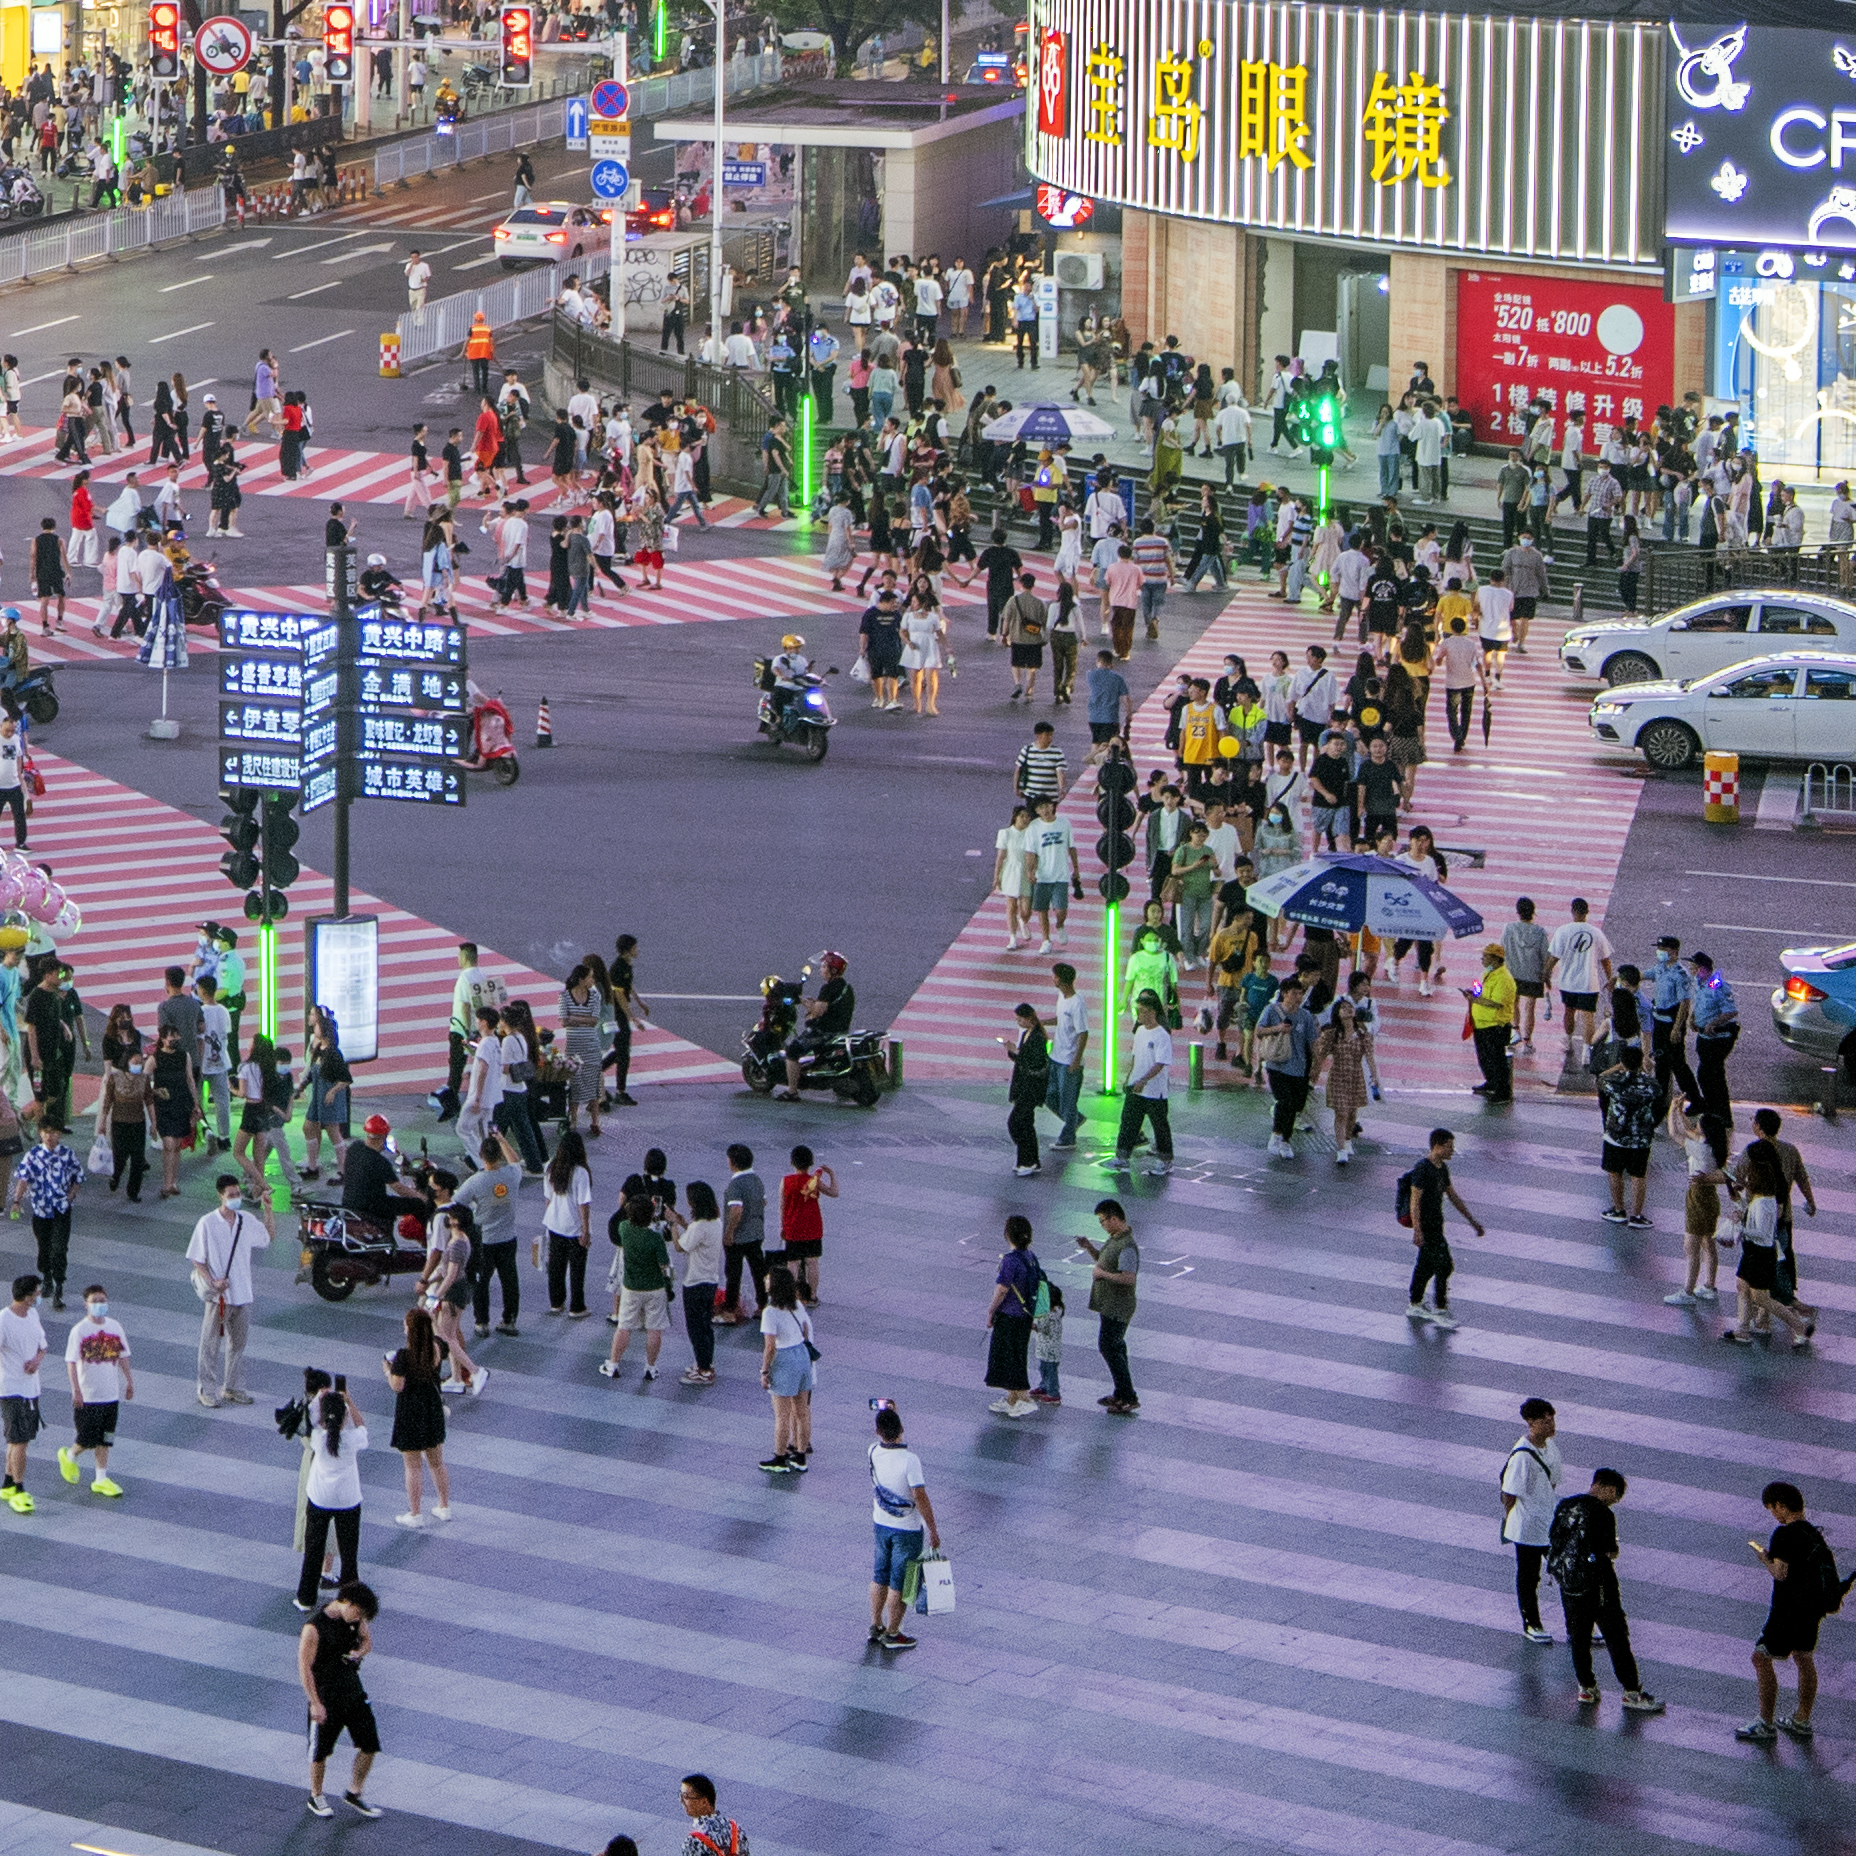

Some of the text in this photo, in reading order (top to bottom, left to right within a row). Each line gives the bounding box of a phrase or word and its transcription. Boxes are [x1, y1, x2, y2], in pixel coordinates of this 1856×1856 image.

[362, 625, 443, 653] 黄兴中路
[362, 671, 442, 699] 金满地
[365, 766, 444, 792] 城市英雄
